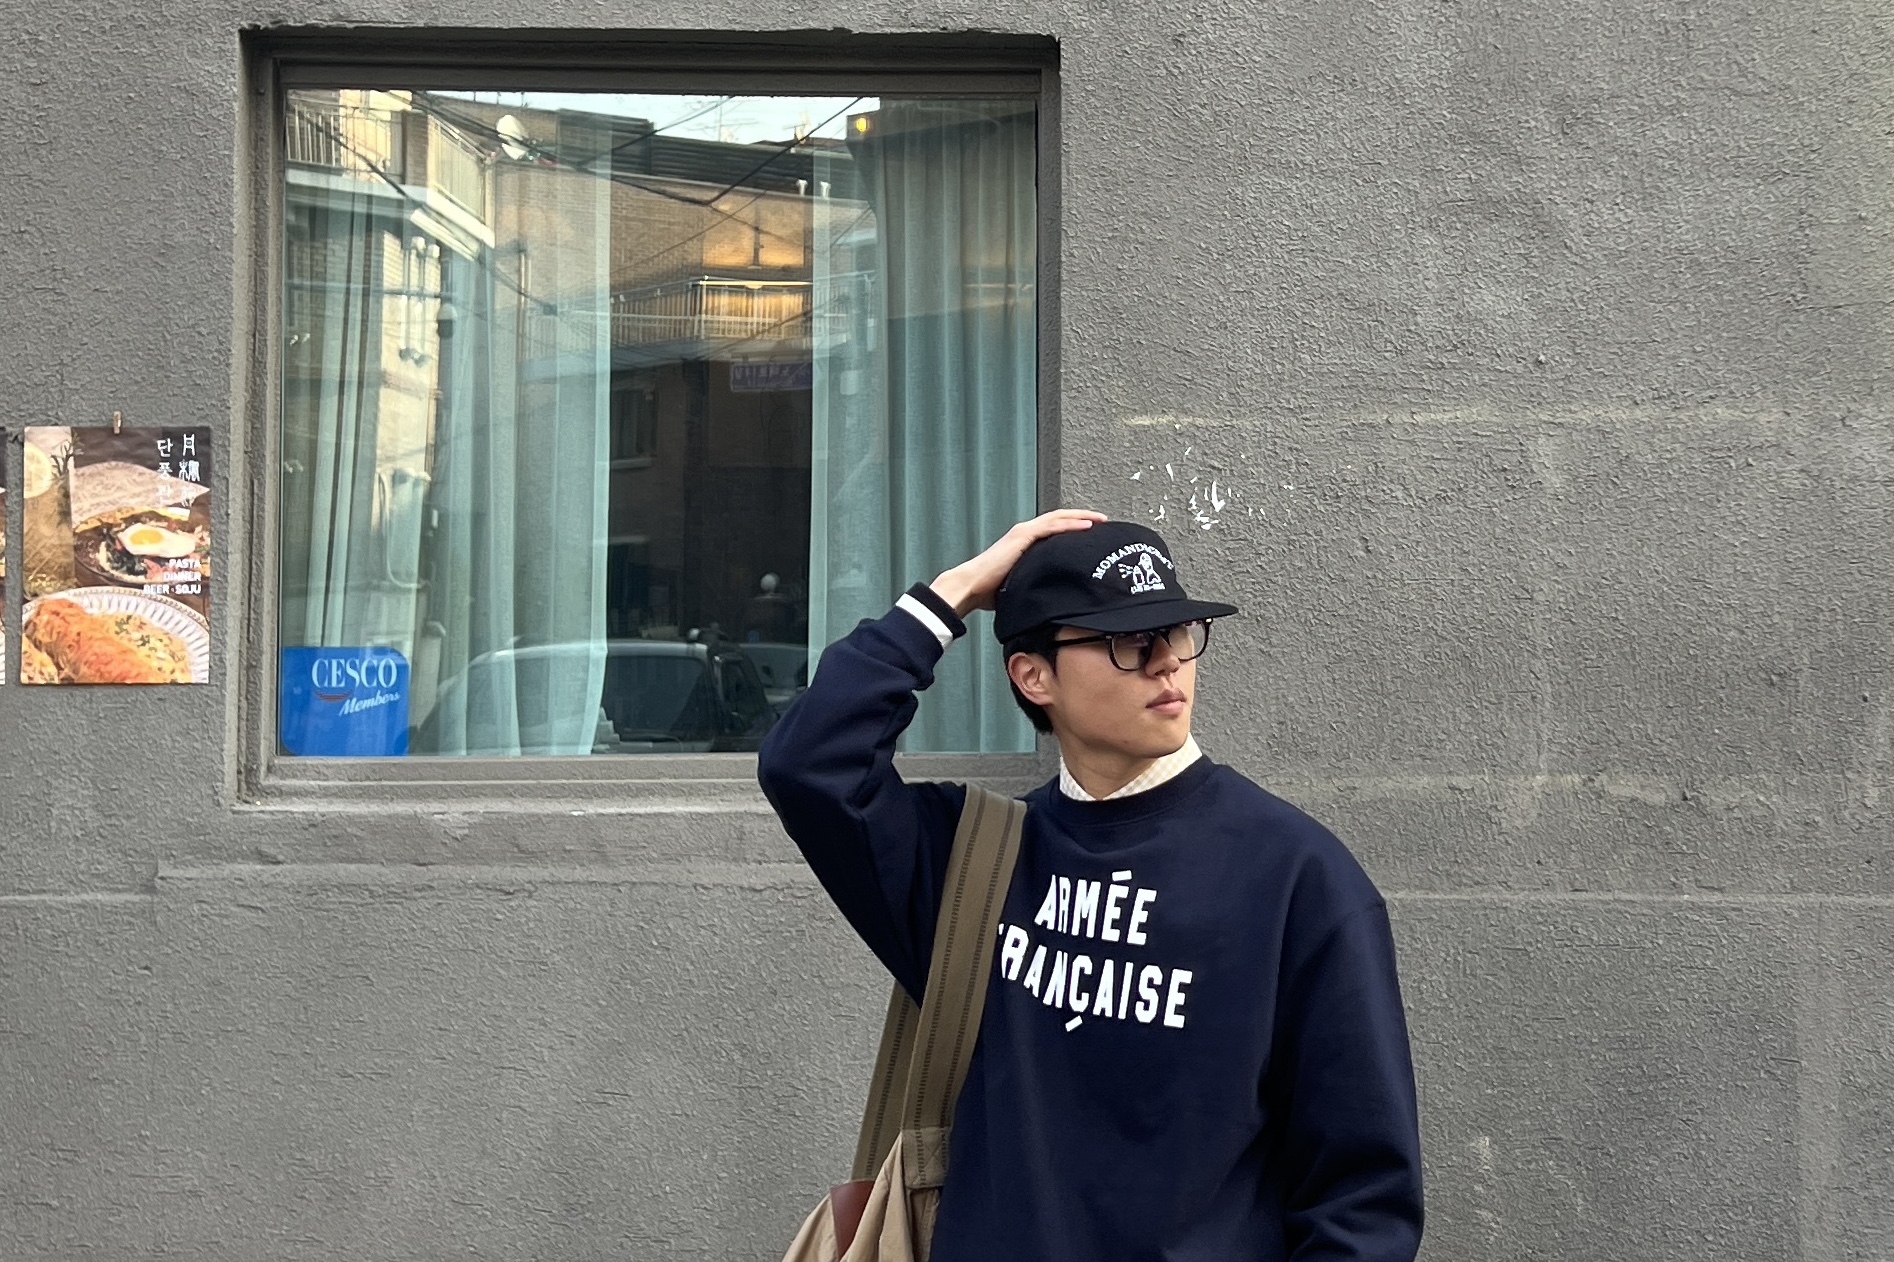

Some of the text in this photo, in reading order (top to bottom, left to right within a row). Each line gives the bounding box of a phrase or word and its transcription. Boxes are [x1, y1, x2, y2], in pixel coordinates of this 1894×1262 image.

[168, 558, 202, 569] PASTA
[311, 657, 398, 690] CESCO
[338, 689, 401, 717] Members
[1034, 869, 1157, 946] ARMÉE
[998, 923, 1193, 1032] RANÇAISE
